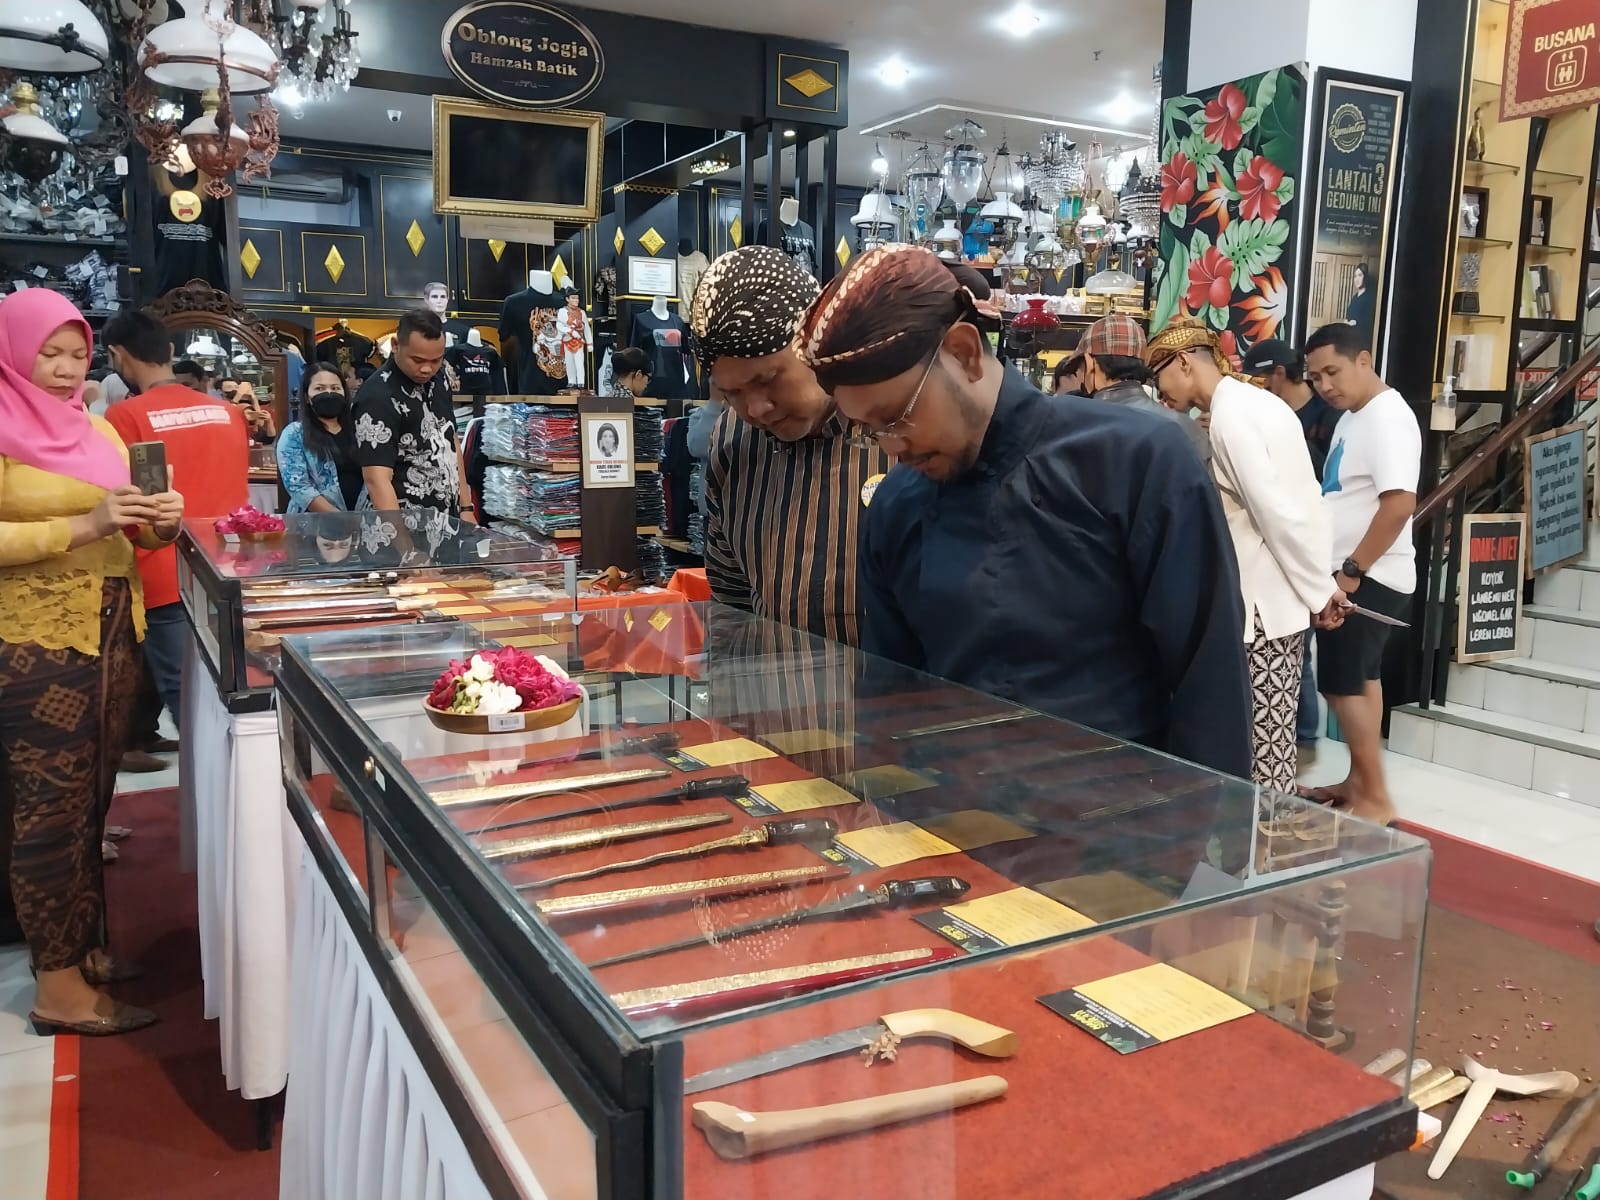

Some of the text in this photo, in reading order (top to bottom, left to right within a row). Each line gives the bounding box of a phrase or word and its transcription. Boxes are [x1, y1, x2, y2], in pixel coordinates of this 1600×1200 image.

[457, 22, 589, 59] Oblong Jogja
[1534, 23, 1595, 53] BUSANA
[470, 51, 578, 77] Hamzah Batik
[1328, 162, 1385, 195] LANTAI 3
[1326, 190, 1381, 214] GEDUNG INI
[1481, 572, 1504, 589] KOYOK
